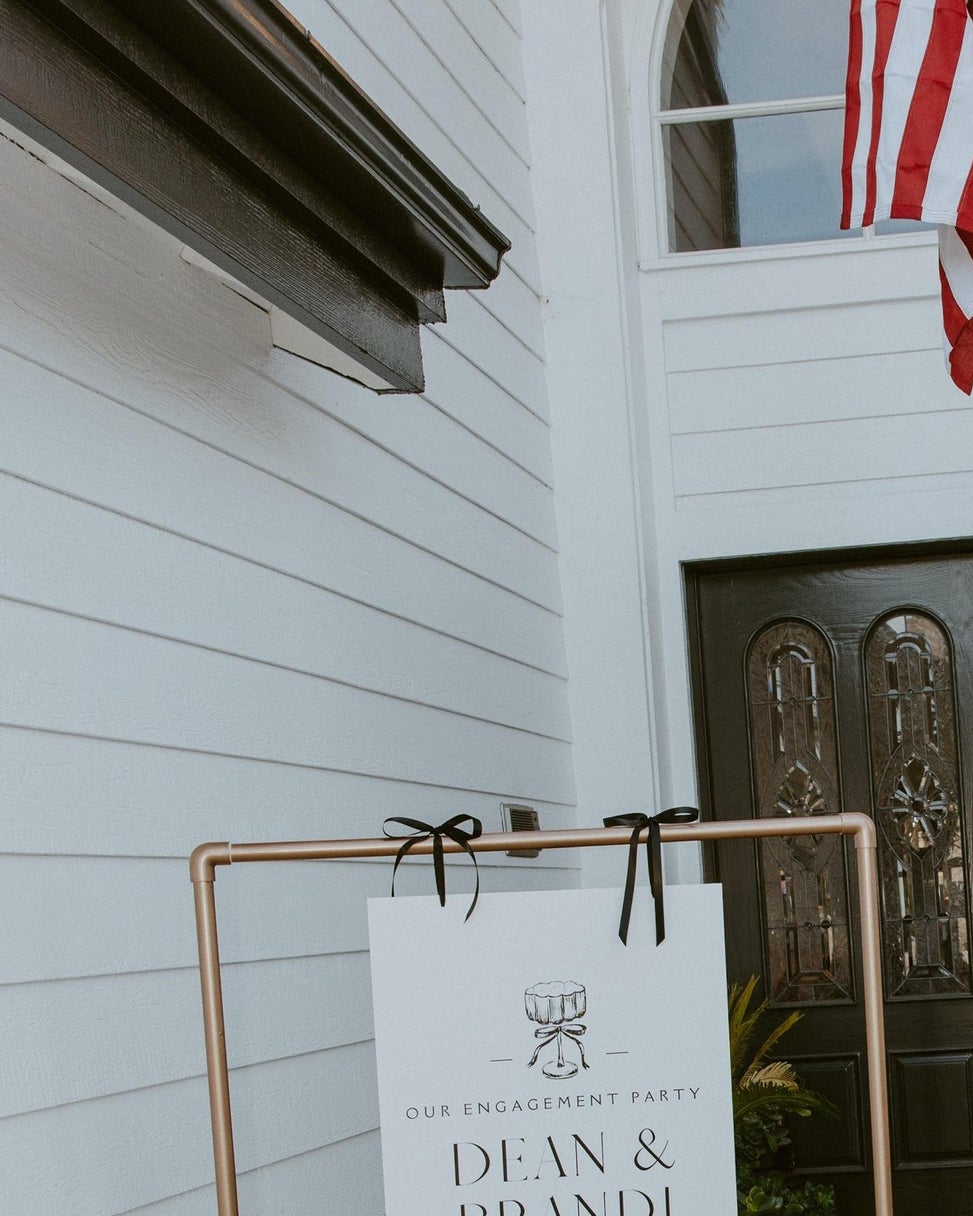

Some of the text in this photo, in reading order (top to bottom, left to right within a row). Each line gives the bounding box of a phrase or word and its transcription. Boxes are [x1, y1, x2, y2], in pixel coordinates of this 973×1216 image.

[405, 1087, 701, 1120] OUR ENGAGEMENT PARTY
[452, 1127, 676, 1187] DEAN &
